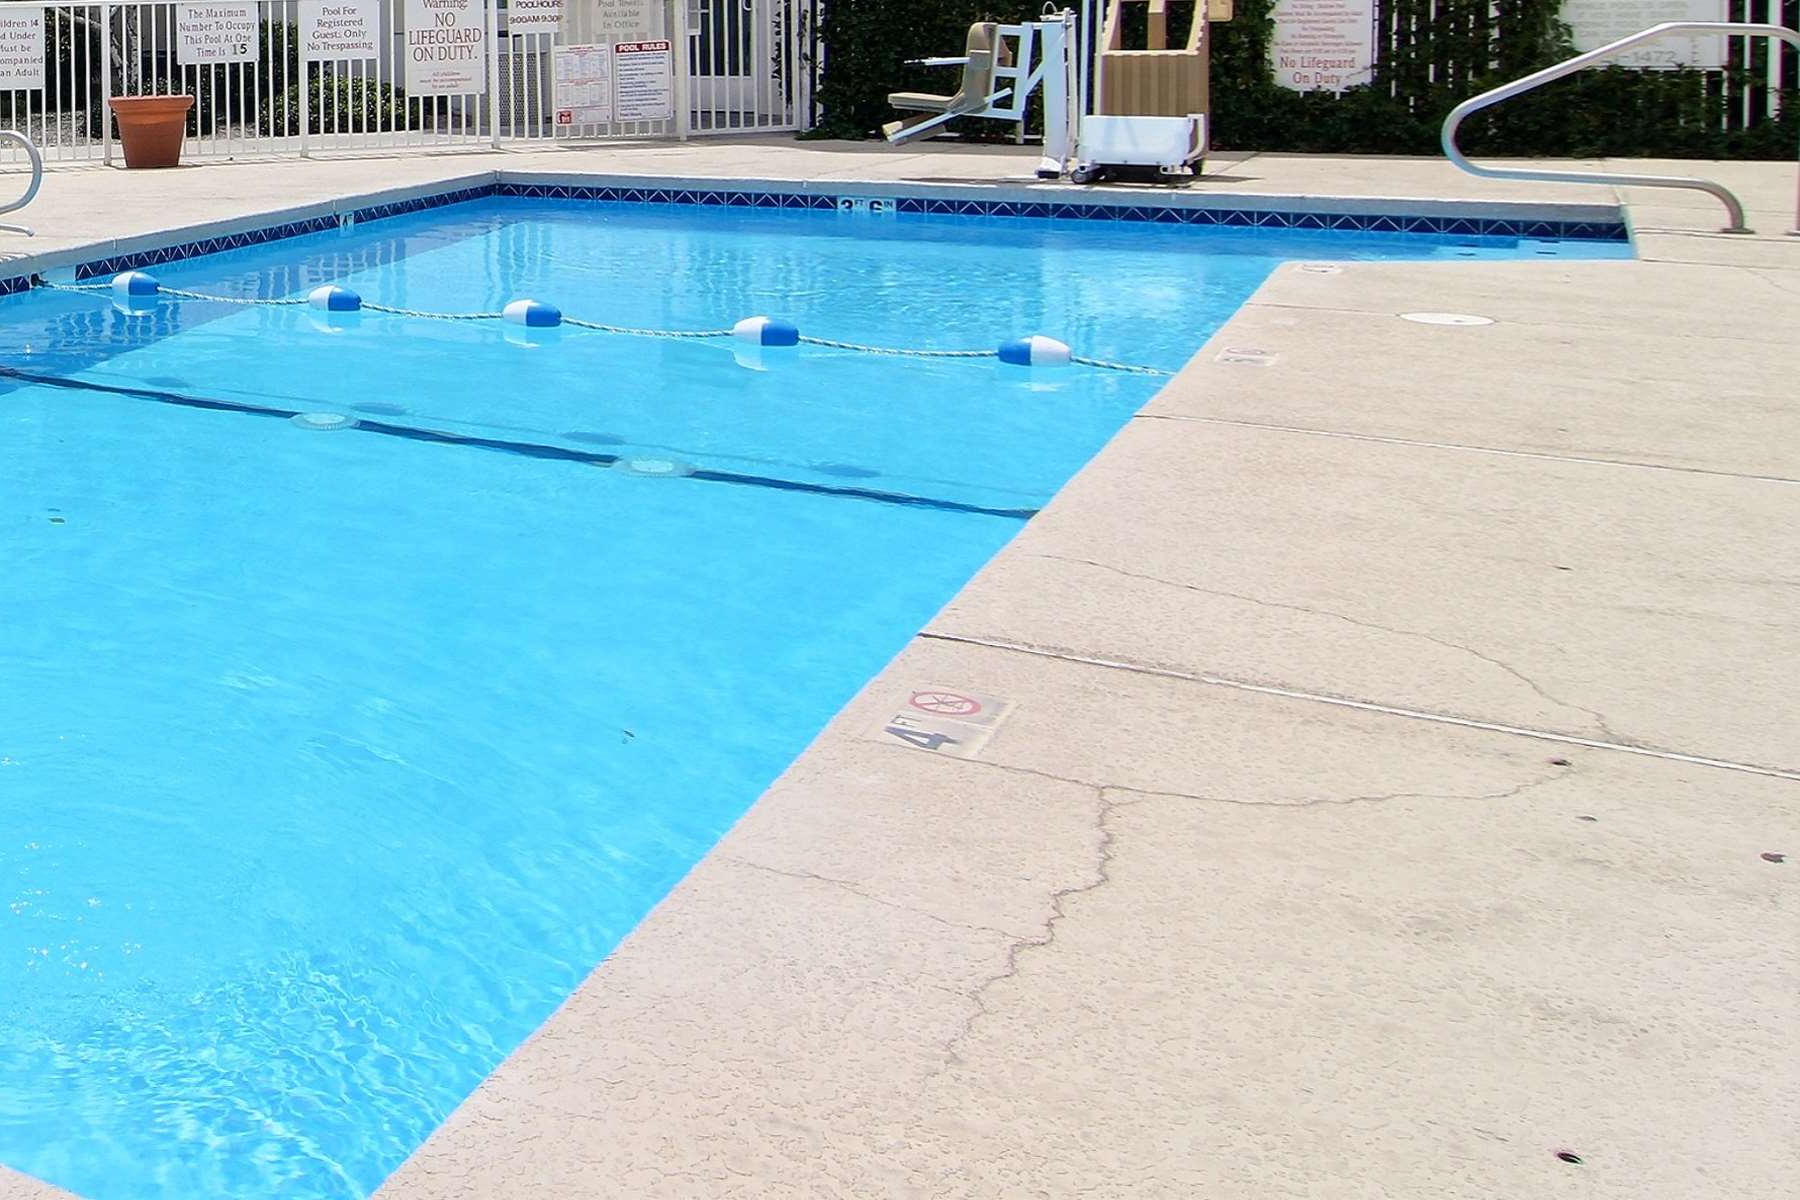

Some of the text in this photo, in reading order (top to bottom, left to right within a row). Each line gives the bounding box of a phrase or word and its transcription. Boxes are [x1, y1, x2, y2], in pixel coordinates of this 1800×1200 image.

[188, 8, 246, 19] The Maximum
[322, 6, 357, 16] Pool For
[317, 18, 363, 29] Registered
[435, 12, 455, 27] NO
[179, 20, 255, 32] Number To Occupy
[9, 32, 36, 40] Under
[184, 33, 251, 45] This Pool At One
[344, 29, 367, 39] Only
[408, 28, 482, 45] LIFEGUARD
[21, 44, 31, 52] be
[197, 47, 217, 57] Time
[232, 43, 247, 55] 15
[307, 41, 373, 51] No Trespassing
[618, 43, 666, 52] POOL RULES
[413, 47, 433, 62] ON
[1280, 56, 1355, 72] No Lifeguard
[15, 69, 40, 77] Adult
[1293, 72, 1340, 85] On Duty
[884, 725, 958, 750] 4
